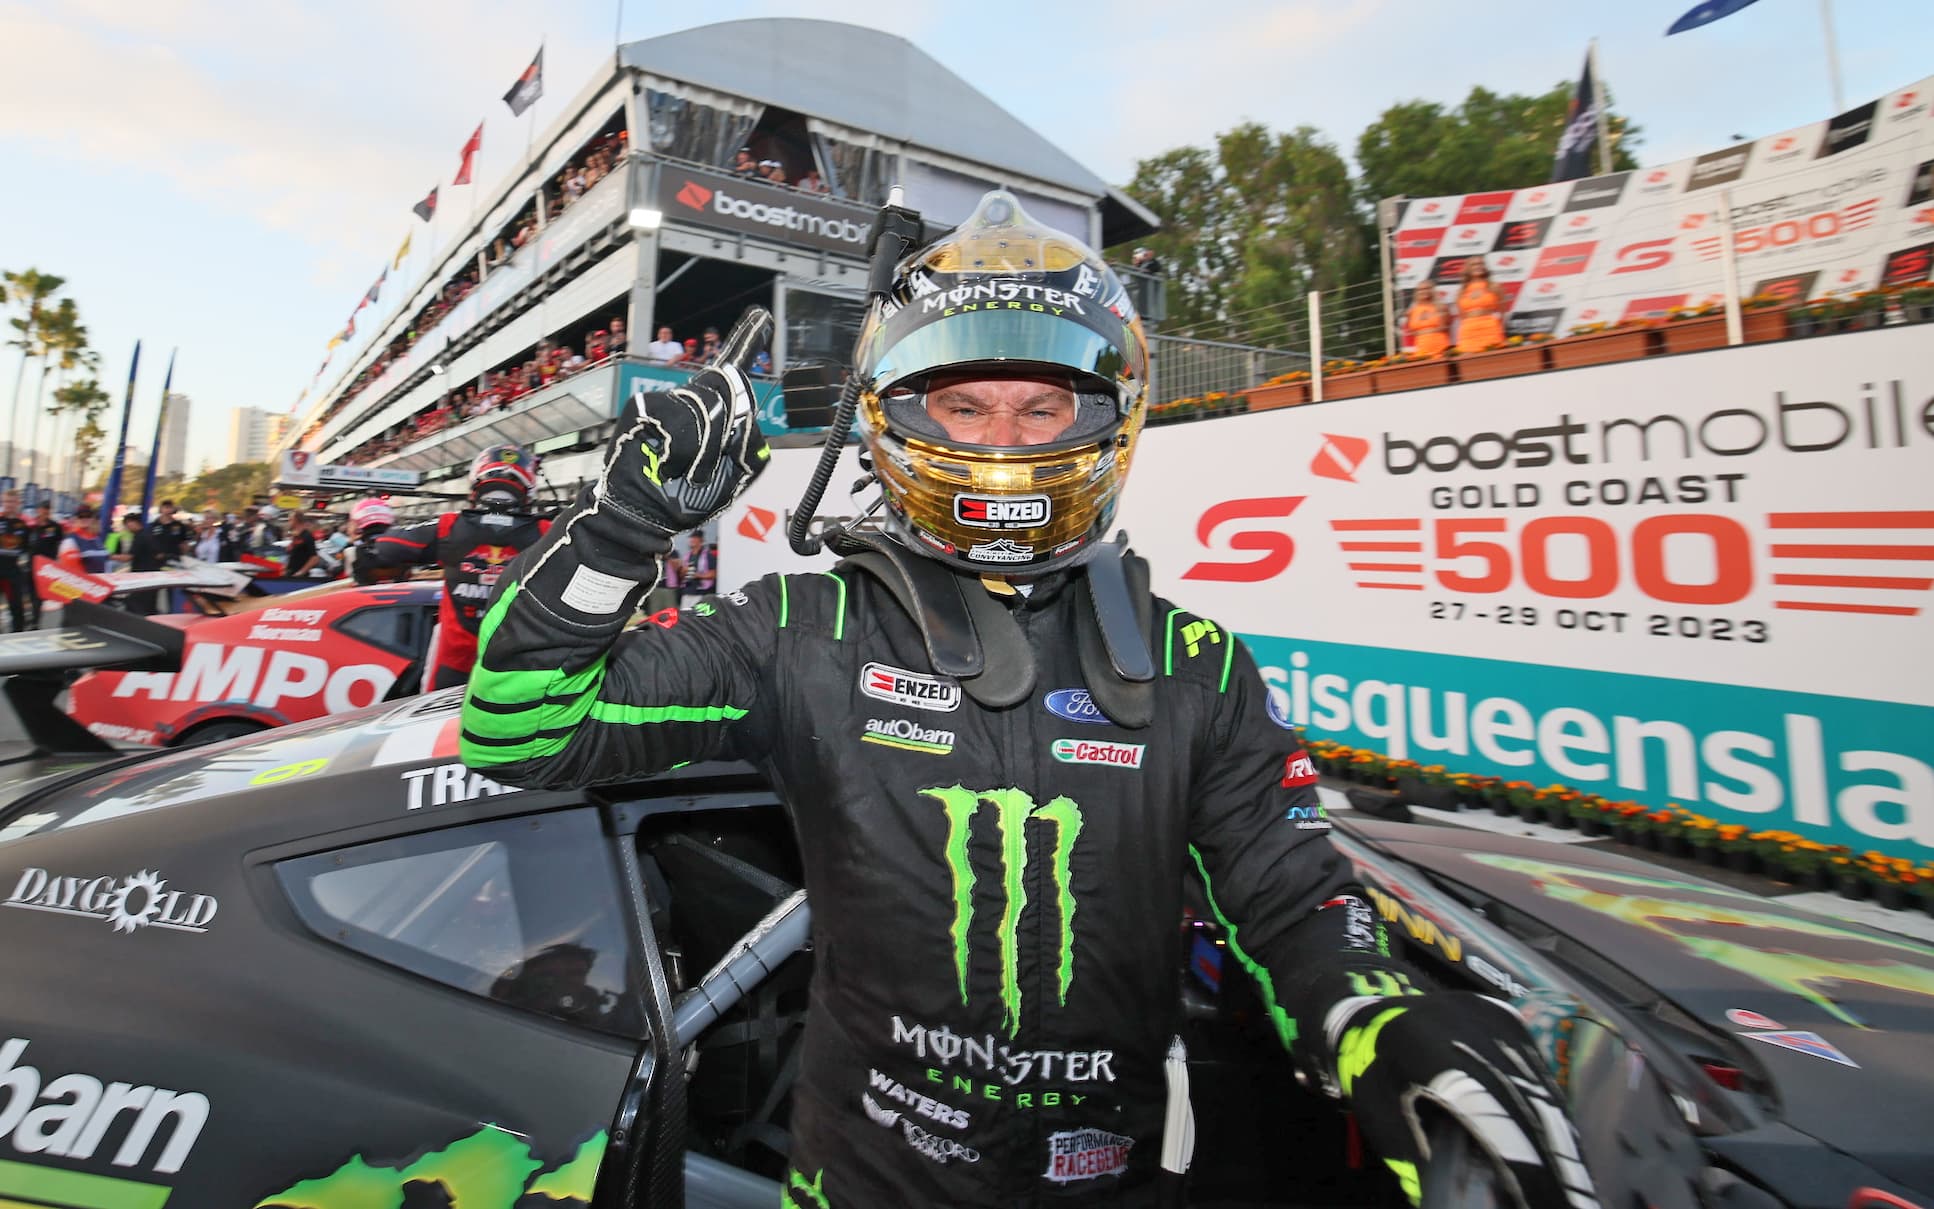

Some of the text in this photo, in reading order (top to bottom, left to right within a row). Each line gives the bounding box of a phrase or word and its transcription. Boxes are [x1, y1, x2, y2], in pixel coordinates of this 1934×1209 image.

[713, 189, 872, 245] boostmobi
[943, 300, 1064, 318] ENERGY
[1384, 380, 1934, 475] boostmobil
[986, 501, 1044, 521] ENZED
[1430, 473, 1748, 510] GOLD COAST
[1433, 513, 1756, 606] 500
[1555, 609, 1630, 634] OCT
[1646, 614, 1772, 645] 2023
[111, 642, 399, 715] AMPO
[894, 678, 952, 701] ENZED
[1076, 742, 1139, 766] Castrol
[1258, 650, 1934, 848] sisqueensla
[400, 762, 524, 811] TRA
[869, 1067, 971, 1130] WATERS
[926, 1067, 1088, 1109] ENERGY
